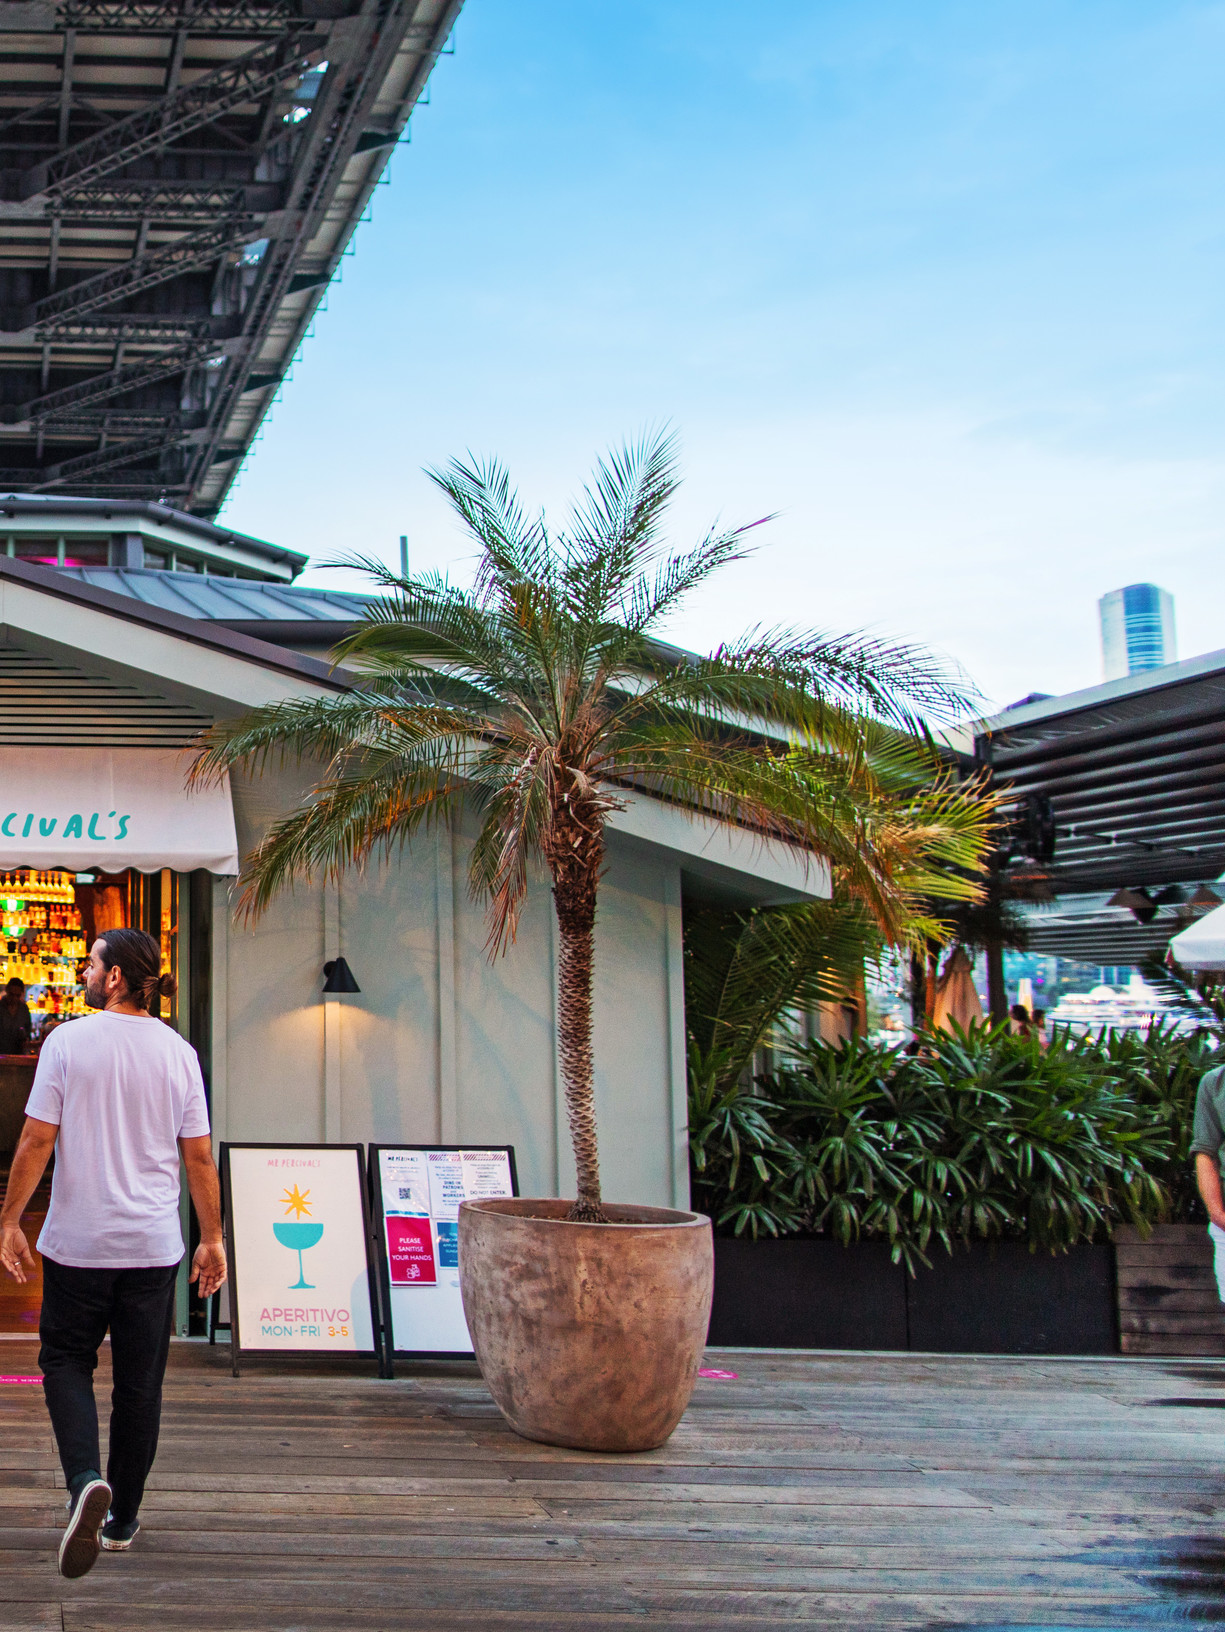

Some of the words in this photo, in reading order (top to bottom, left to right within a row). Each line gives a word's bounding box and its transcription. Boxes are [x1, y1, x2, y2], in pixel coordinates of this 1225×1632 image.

[267, 1159, 279, 1168] MR
[260, 1307, 350, 1322] APERITIVO
[327, 1326, 349, 1337] 3-5
